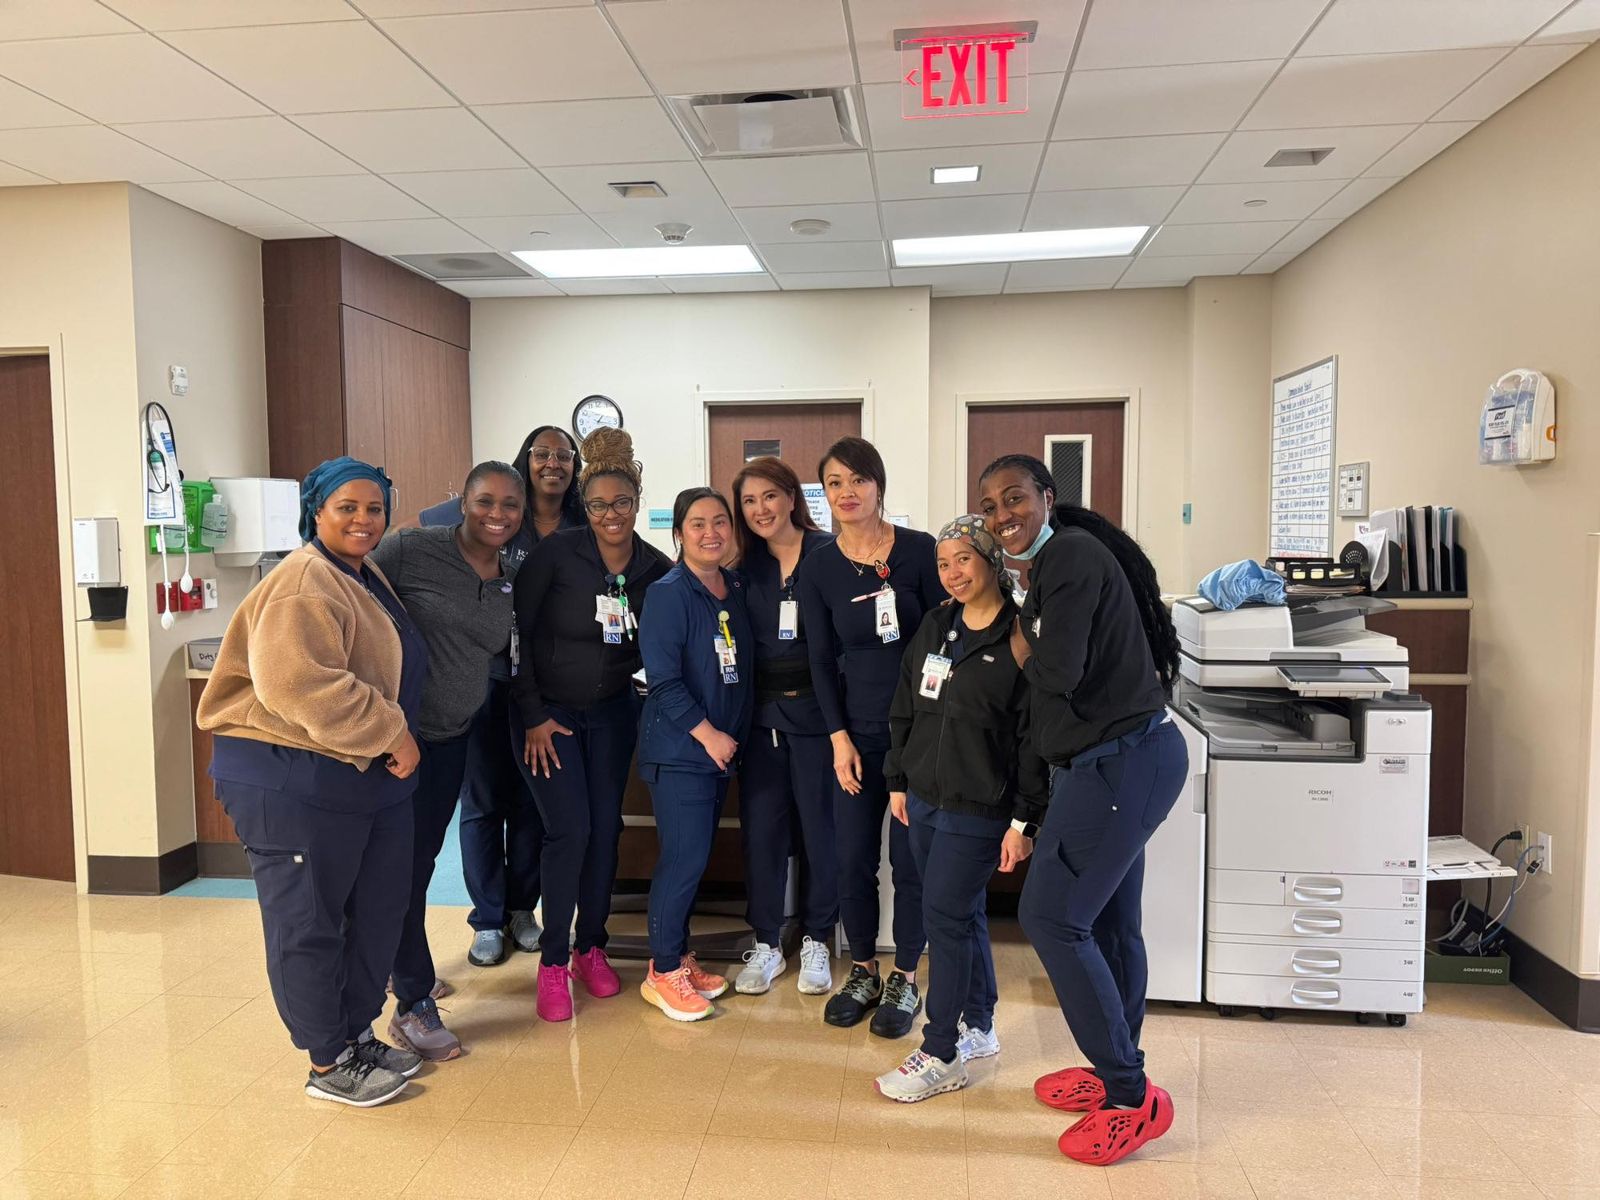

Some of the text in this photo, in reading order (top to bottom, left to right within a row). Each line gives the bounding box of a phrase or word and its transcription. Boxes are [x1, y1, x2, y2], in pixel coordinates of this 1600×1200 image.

[922, 39, 1016, 108] EXIT
[804, 489, 825, 497] OTICE
[606, 633, 619, 642] RN
[884, 630, 898, 641] RN
[725, 672, 737, 682] RN
